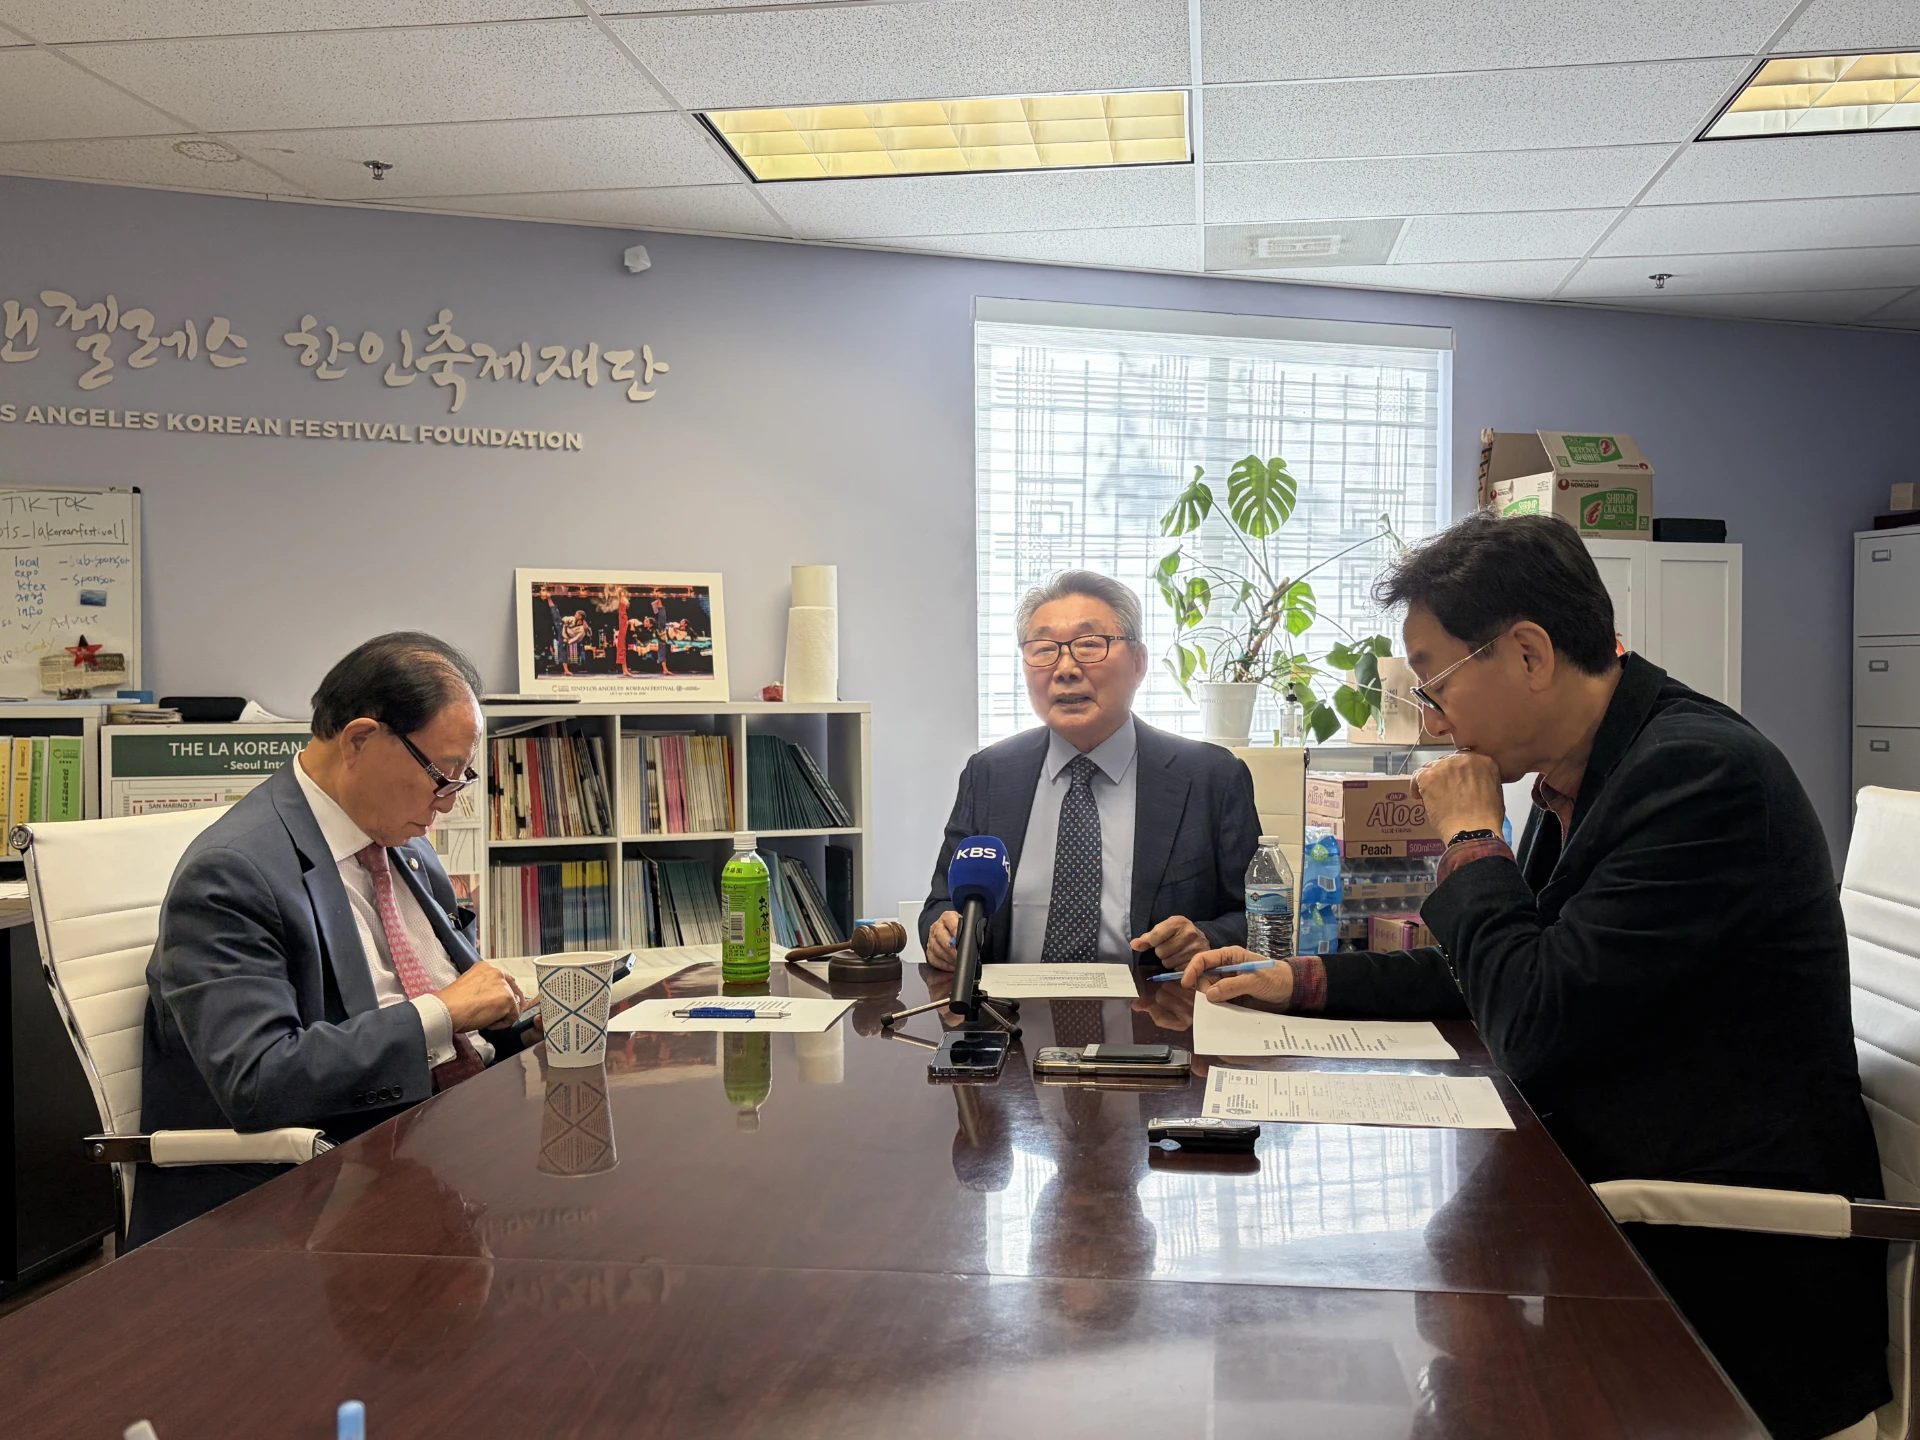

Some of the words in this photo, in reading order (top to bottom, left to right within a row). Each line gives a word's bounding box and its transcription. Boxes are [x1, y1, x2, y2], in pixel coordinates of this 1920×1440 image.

[284, 308, 670, 413] 한인축제재단
[25, 405, 160, 431] ANGELES
[167, 413, 282, 436] KOREAN
[290, 419, 412, 443] FESTIVAL
[419, 425, 583, 451] FOUNDATION
[1606, 493, 1635, 504] SHRIMP
[1604, 504, 1635, 515] CRACKERS
[169, 742, 204, 757] THE
[208, 742, 230, 756] LA
[234, 741, 302, 756] KOREAN
[230, 760, 261, 771] Seoul
[1366, 801, 1426, 828] Aloe
[956, 847, 997, 860] KBS
[1360, 844, 1392, 856] Peach
